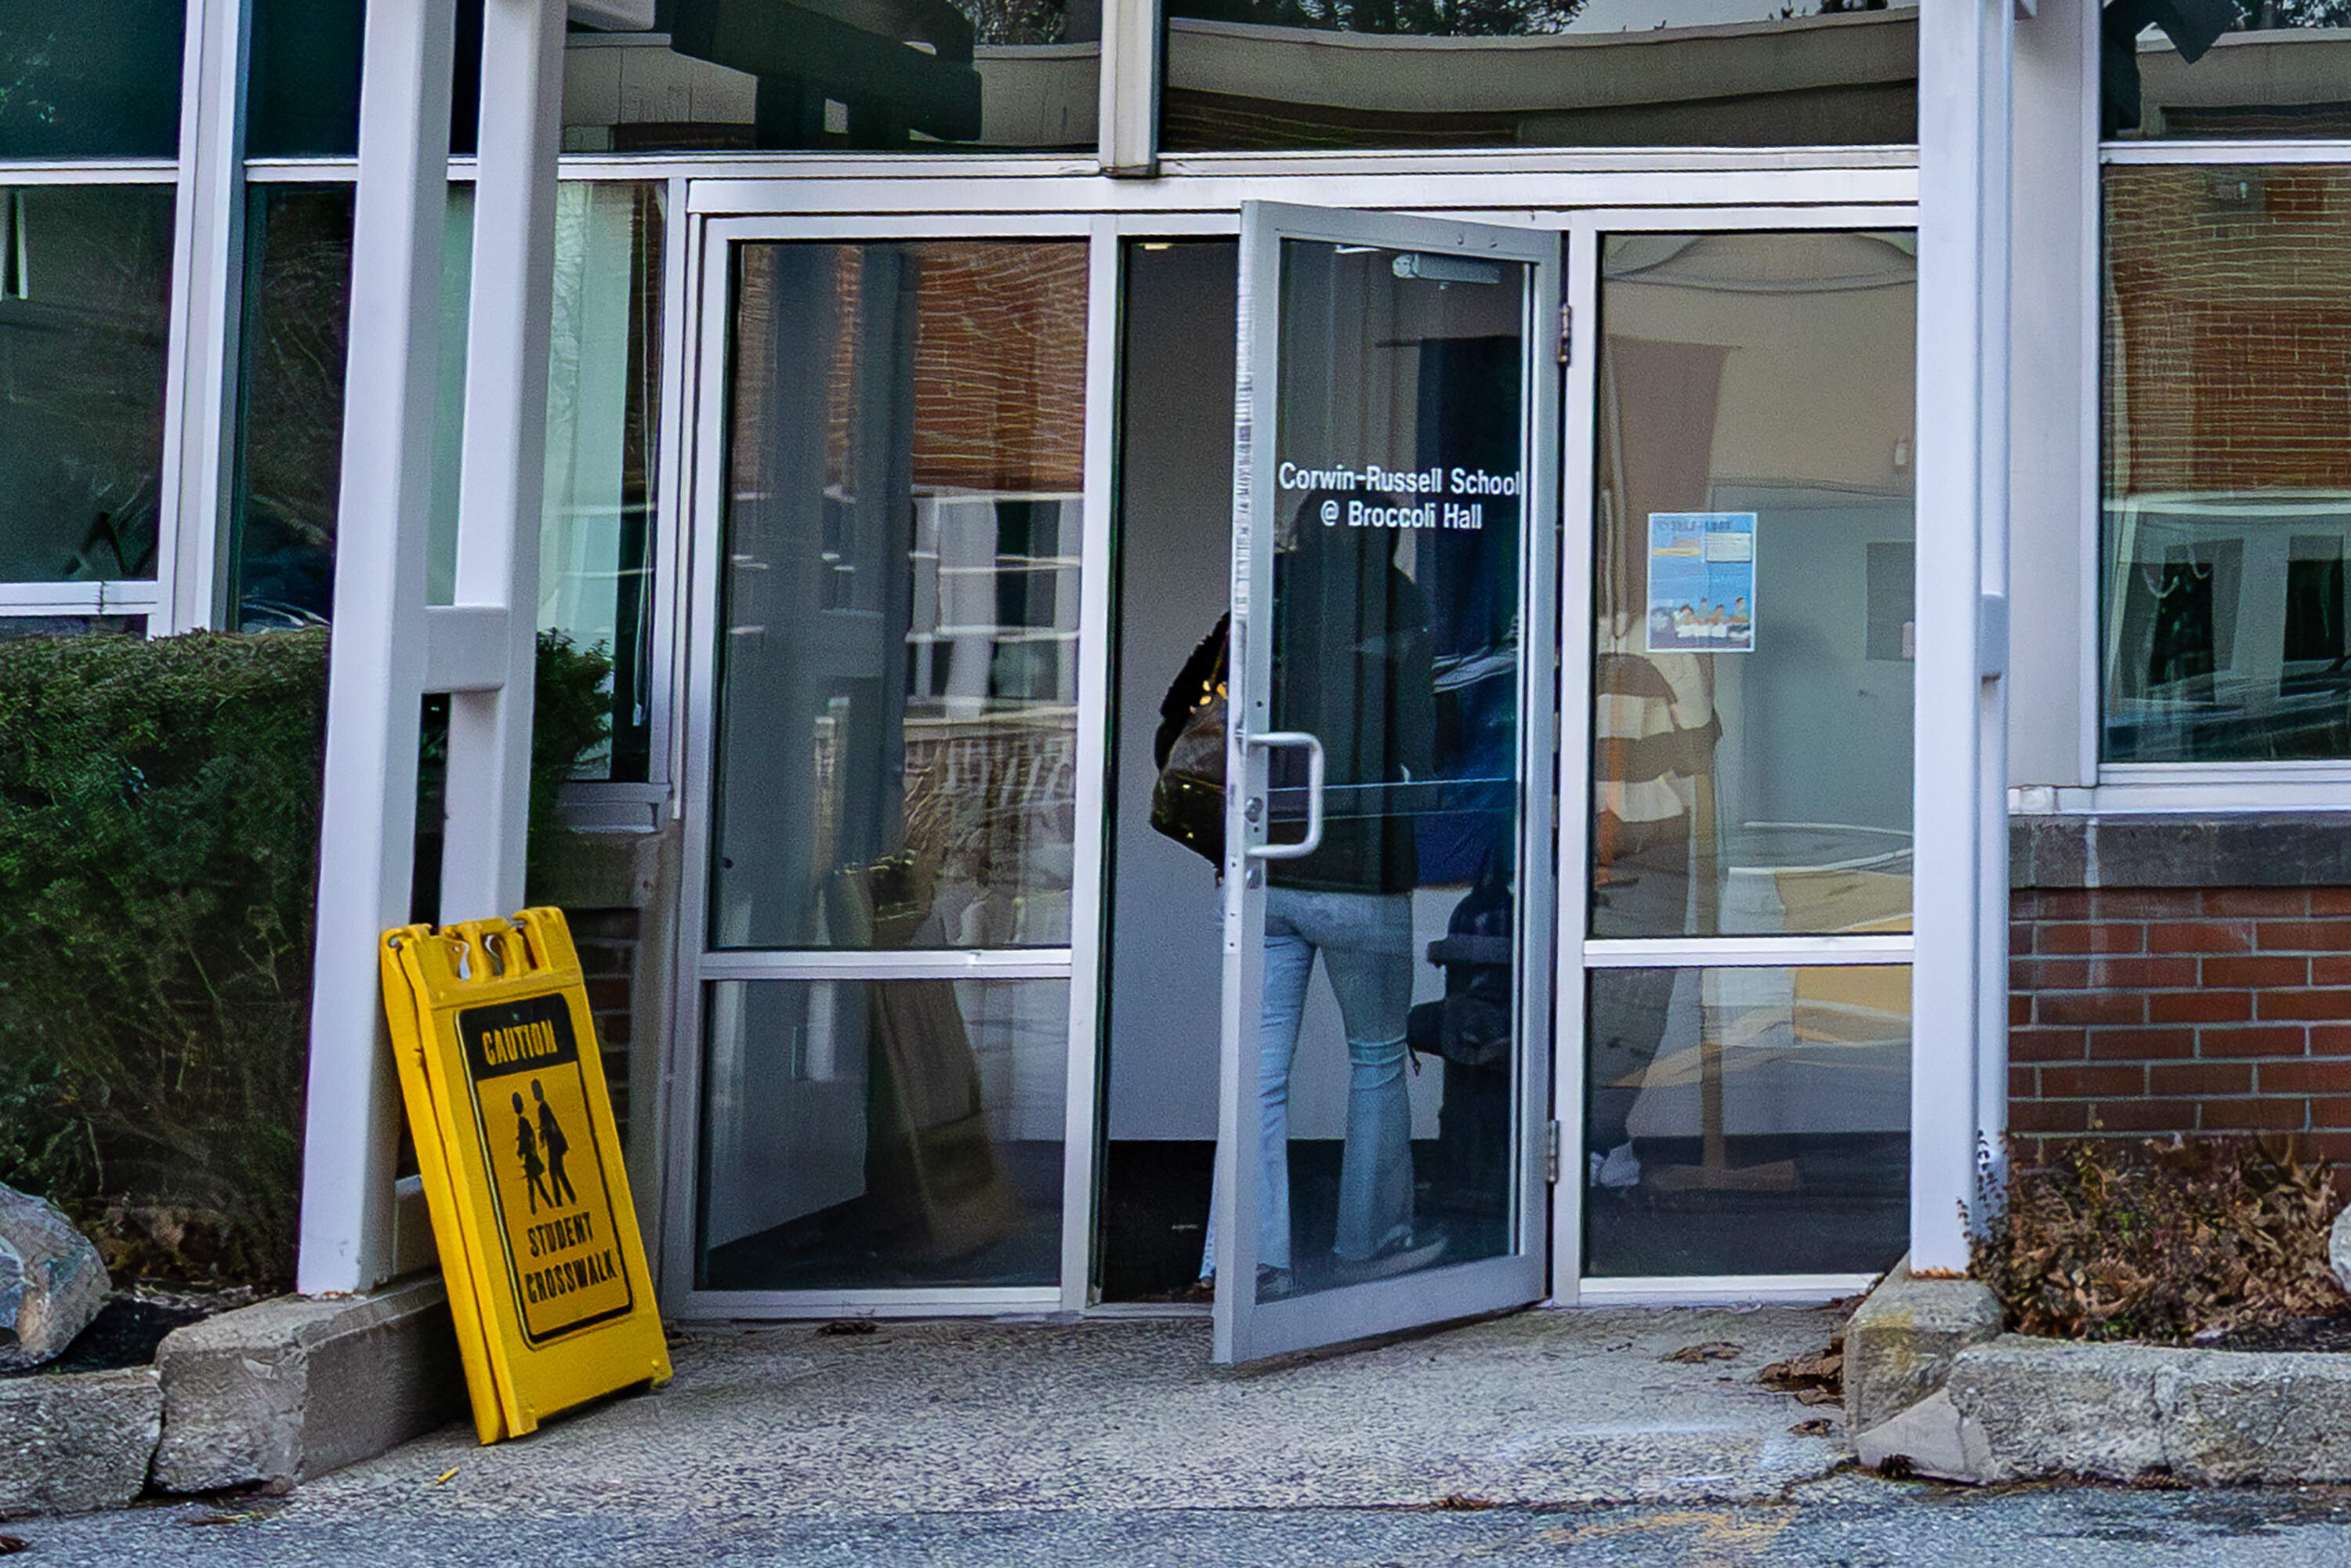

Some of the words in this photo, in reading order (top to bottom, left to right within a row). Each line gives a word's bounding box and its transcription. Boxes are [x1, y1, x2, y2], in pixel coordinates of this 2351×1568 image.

[1278, 461, 1442, 494] Corwin-Russell
[1450, 467, 1521, 495] School
[1320, 499, 1339, 527] @
[1347, 500, 1436, 528] Broccoli
[1443, 502, 1483, 530] Hall
[481, 1019, 558, 1066] CAUTION
[527, 1211, 594, 1258] STUDENT
[524, 1248, 618, 1304] CROSSWALK
